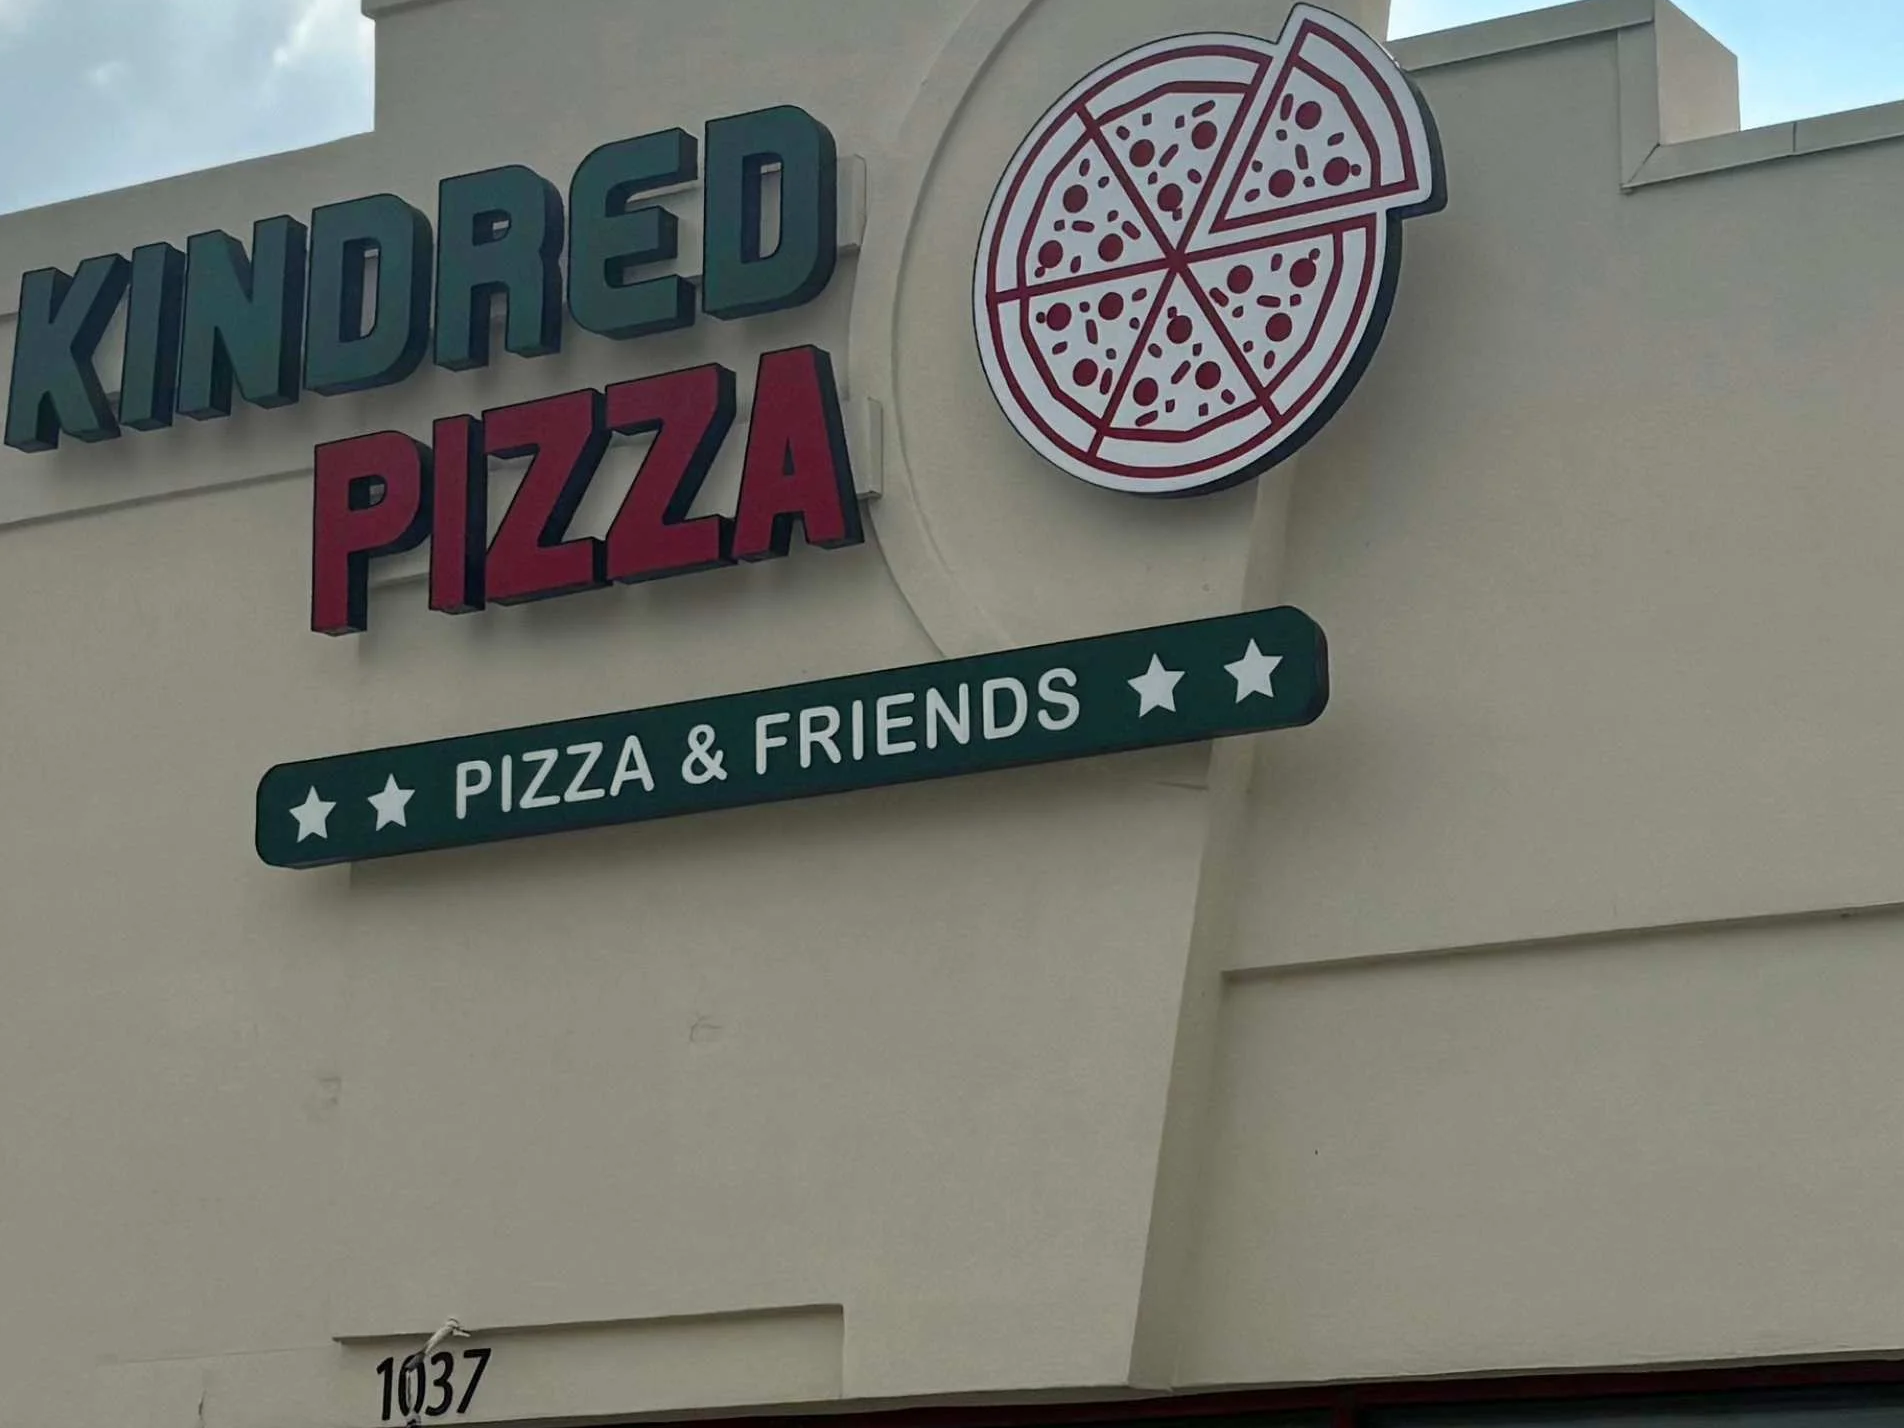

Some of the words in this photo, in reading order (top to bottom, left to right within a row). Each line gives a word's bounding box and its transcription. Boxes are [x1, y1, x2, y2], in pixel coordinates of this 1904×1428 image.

[6, 104, 836, 452] KINDRED
[311, 344, 865, 635] PIZZA
[456, 734, 654, 820] PIZZA
[681, 724, 726, 786] &
[754, 667, 1080, 775] FRIENDS
[375, 1347, 492, 1421] 1037
